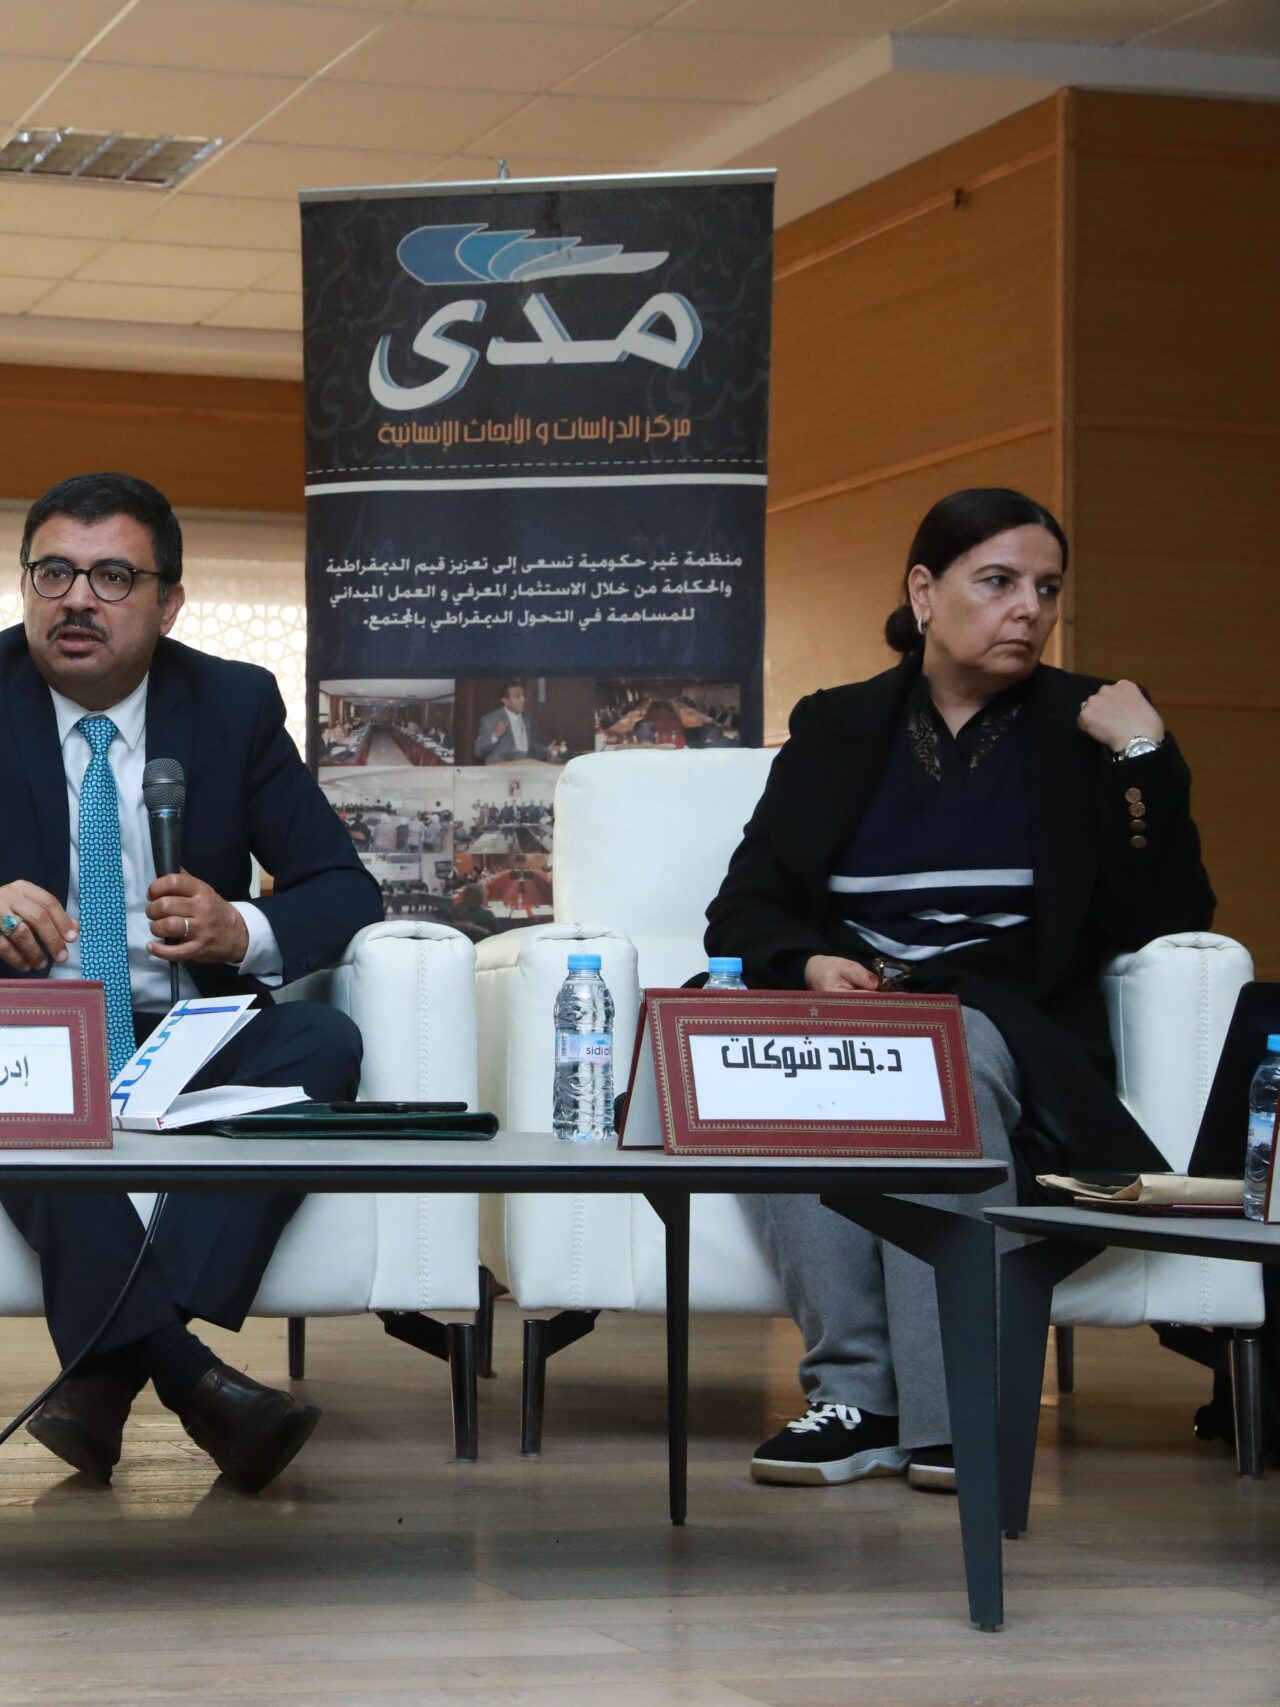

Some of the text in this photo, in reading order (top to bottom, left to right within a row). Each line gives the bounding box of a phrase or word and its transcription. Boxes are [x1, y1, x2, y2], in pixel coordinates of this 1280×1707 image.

[369, 293, 703, 410] مدى
[378, 413, 691, 451] مركز الدراسات و الأبحاث الإنسانية
[326, 552, 743, 576] منظمة غير حكومية تسعى إلى تعزيز قيم الديمقراطية
[330, 579, 732, 607] والحكامة من خلال الاستثمار المعرفي و العمل الميداني
[430, 610, 513, 633] الديمقراطي
[517, 610, 574, 627] التحول
[579, 609, 602, 631] في
[607, 607, 695, 622] للمساهمة
[721, 1036, 822, 1078] شوكات
